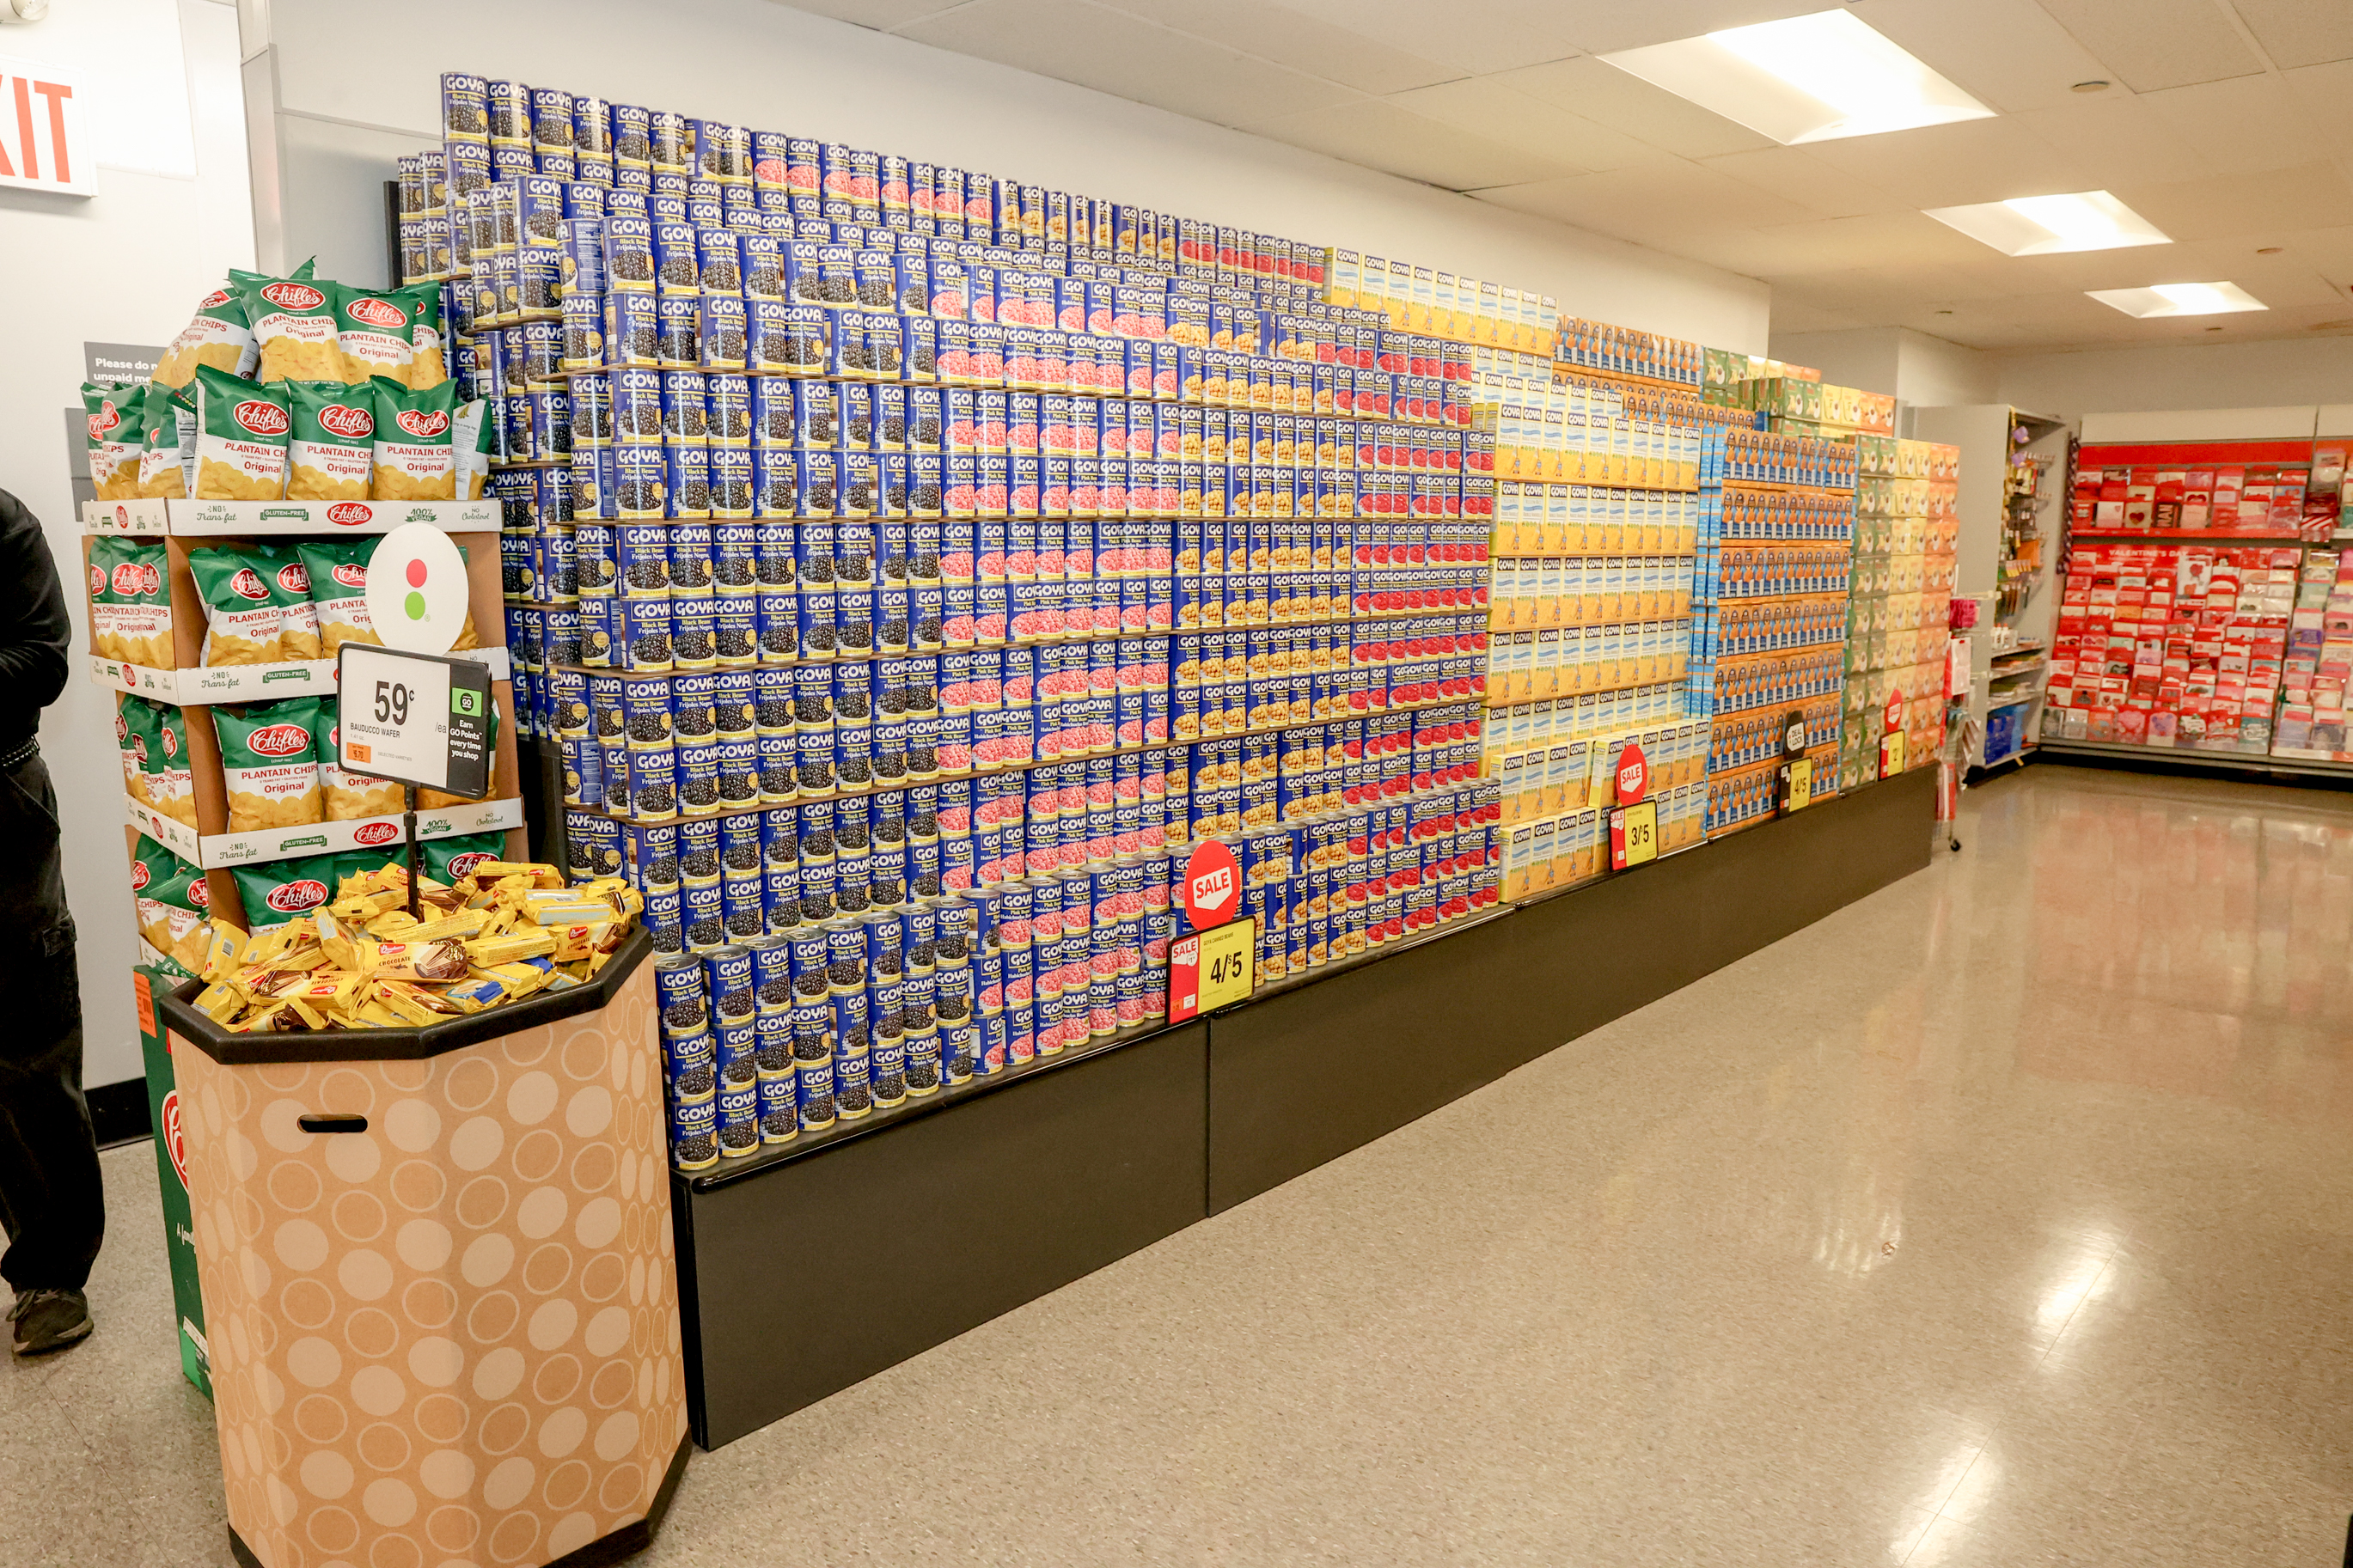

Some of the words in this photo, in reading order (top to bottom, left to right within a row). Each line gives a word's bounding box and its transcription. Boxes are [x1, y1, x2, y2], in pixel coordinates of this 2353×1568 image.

[446, 76, 486, 94] GOYA
[490, 84, 528, 98] GOYA
[536, 92, 571, 107] GOYA
[577, 101, 609, 117] GOYA
[652, 114, 684, 128] GOYA
[759, 133, 786, 147] GOYA
[791, 140, 818, 153] GOYA
[455, 145, 490, 162] GOYA
[496, 152, 532, 167] GOYA
[689, 183, 721, 198] GOYA
[728, 212, 761, 226] GOYA
[611, 219, 651, 235] GOYA
[1337, 250, 1358, 264] GOYA
[1391, 263, 1409, 275] GOYA
[1024, 274, 1053, 288] GOYA
[1438, 273, 1454, 285] GOYA
[266, 284, 320, 306] Chifles
[1482, 283, 1497, 295] GOYA
[1542, 296, 1556, 308] GOYA
[351, 301, 403, 326] Chifles
[201, 320, 228, 332] CHIPS
[263, 314, 309, 327] PLANTAIN
[286, 326, 324, 339] Original
[970, 326, 1002, 339] GOYA
[340, 334, 386, 345] PLANTAIN
[389, 339, 411, 353] CHIPS
[360, 347, 399, 359] Original
[95, 357, 133, 369] Please
[135, 358, 150, 369] do
[94, 373, 132, 382] unpaid
[622, 374, 659, 389] GOYA
[709, 379, 749, 393] GOYA
[235, 403, 286, 431] Chifles
[1502, 406, 1520, 418] GOYA
[320, 407, 370, 436] Chifles
[402, 412, 446, 434] Chifles
[1568, 416, 1586, 426] GOYA
[1685, 429, 1699, 438] GOYA
[225, 442, 270, 455] PLANTAIN
[308, 446, 354, 458] PLANTAIN
[388, 447, 433, 456] PLANTAIN
[618, 449, 660, 465] GOYA
[244, 461, 281, 473] Original
[327, 463, 365, 474] Original
[407, 462, 444, 472] Original
[1525, 485, 1543, 496] GOYA
[197, 513, 221, 522] Trans
[223, 511, 236, 523] fat
[329, 505, 370, 522] Chifles
[669, 529, 710, 543] GOYA
[715, 600, 753, 614] GOYA
[229, 613, 270, 624] PLANTAIN
[251, 626, 279, 637] Original
[266, 670, 307, 680] GLUTEN-FREE
[755, 672, 792, 686] GOYA
[201, 680, 226, 688] Trans
[228, 679, 240, 689] fat
[627, 683, 669, 698] GOYA
[631, 706, 650, 715] Frijoles
[351, 723, 380, 735] BAUDUCCO
[381, 728, 400, 738] WAFER
[435, 722, 447, 734] /ea
[460, 719, 474, 729] Earn
[1792, 729, 1802, 738] DEAL
[251, 727, 308, 755] Chifles
[450, 740, 468, 749] every
[1792, 737, 1803, 746] LOCK
[463, 750, 479, 761] shop
[718, 742, 755, 758] GOYA
[1506, 759, 1524, 770] GOYA
[241, 767, 291, 780] PLANTAIN
[294, 764, 318, 774] CHIPS
[1622, 766, 1641, 784] SALE
[265, 782, 305, 795] Original
[476, 816, 504, 826] Cholesterol
[1610, 813, 1623, 823] SALE
[358, 826, 396, 842] Chifles
[1535, 822, 1554, 838] GOYA
[284, 837, 323, 847] GLUTEN-FREE
[220, 850, 243, 860] Trans
[244, 849, 259, 857] fat
[801, 865, 834, 880] GOYA
[1196, 871, 1230, 900] SALE
[270, 882, 325, 909] Chifles
[1004, 894, 1031, 907] GOYA
[567, 937, 590, 950] CHOCOLATE
[1173, 941, 1196, 959] SALE
[379, 956, 411, 967] CHOCOLATE
[663, 967, 701, 987] GOYA
[935, 968, 968, 984] GOYA
[791, 1005, 828, 1022] GOYA
[678, 1102, 715, 1121] GOYA
[682, 1127, 699, 1137] Frijoles
